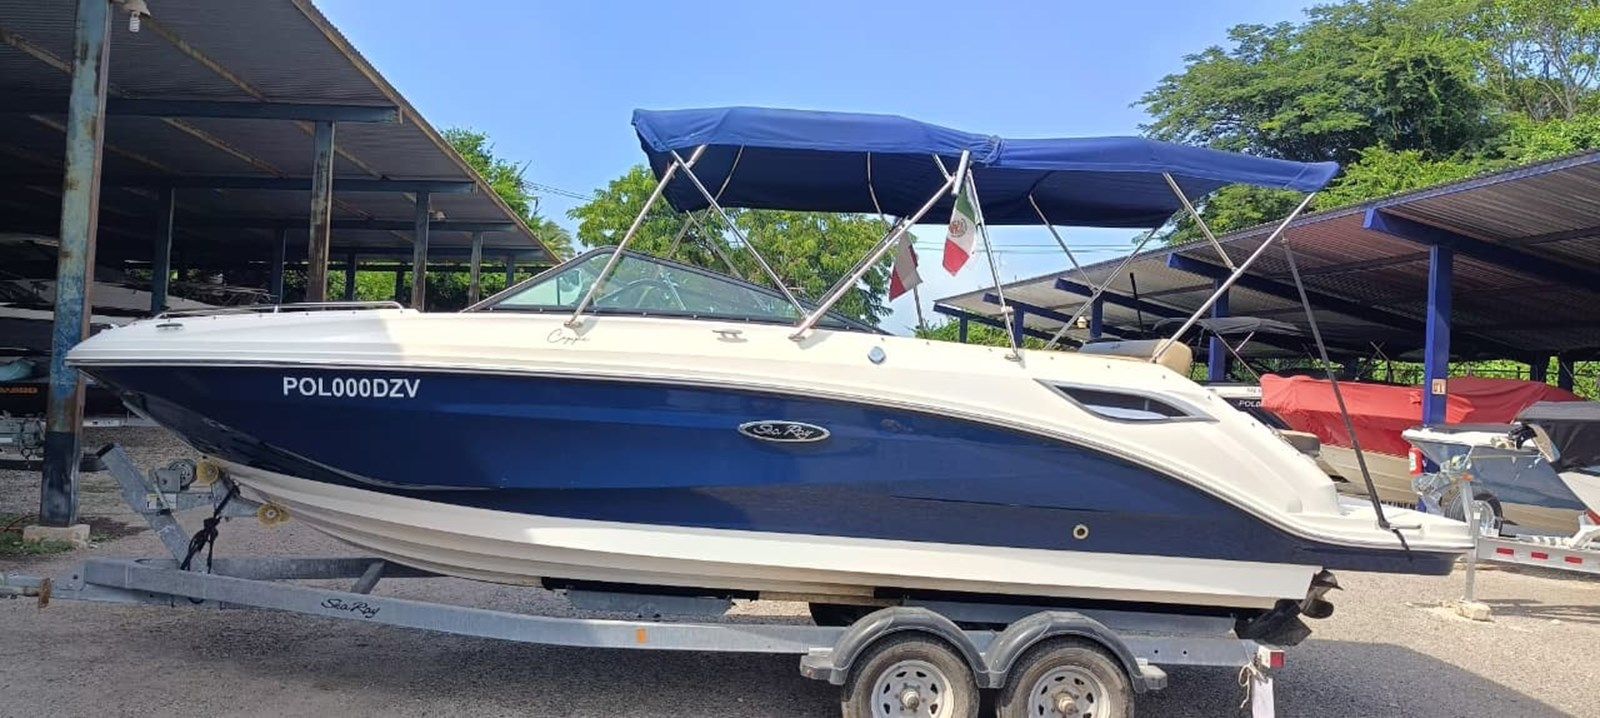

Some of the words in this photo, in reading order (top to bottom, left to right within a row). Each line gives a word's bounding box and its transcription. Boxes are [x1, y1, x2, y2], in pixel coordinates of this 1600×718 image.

[282, 376, 421, 398] POL000DZV
[752, 423, 780, 436] Sea
[783, 424, 814, 440] Ray
[321, 598, 350, 611] Sea
[350, 601, 380, 619] Ray
